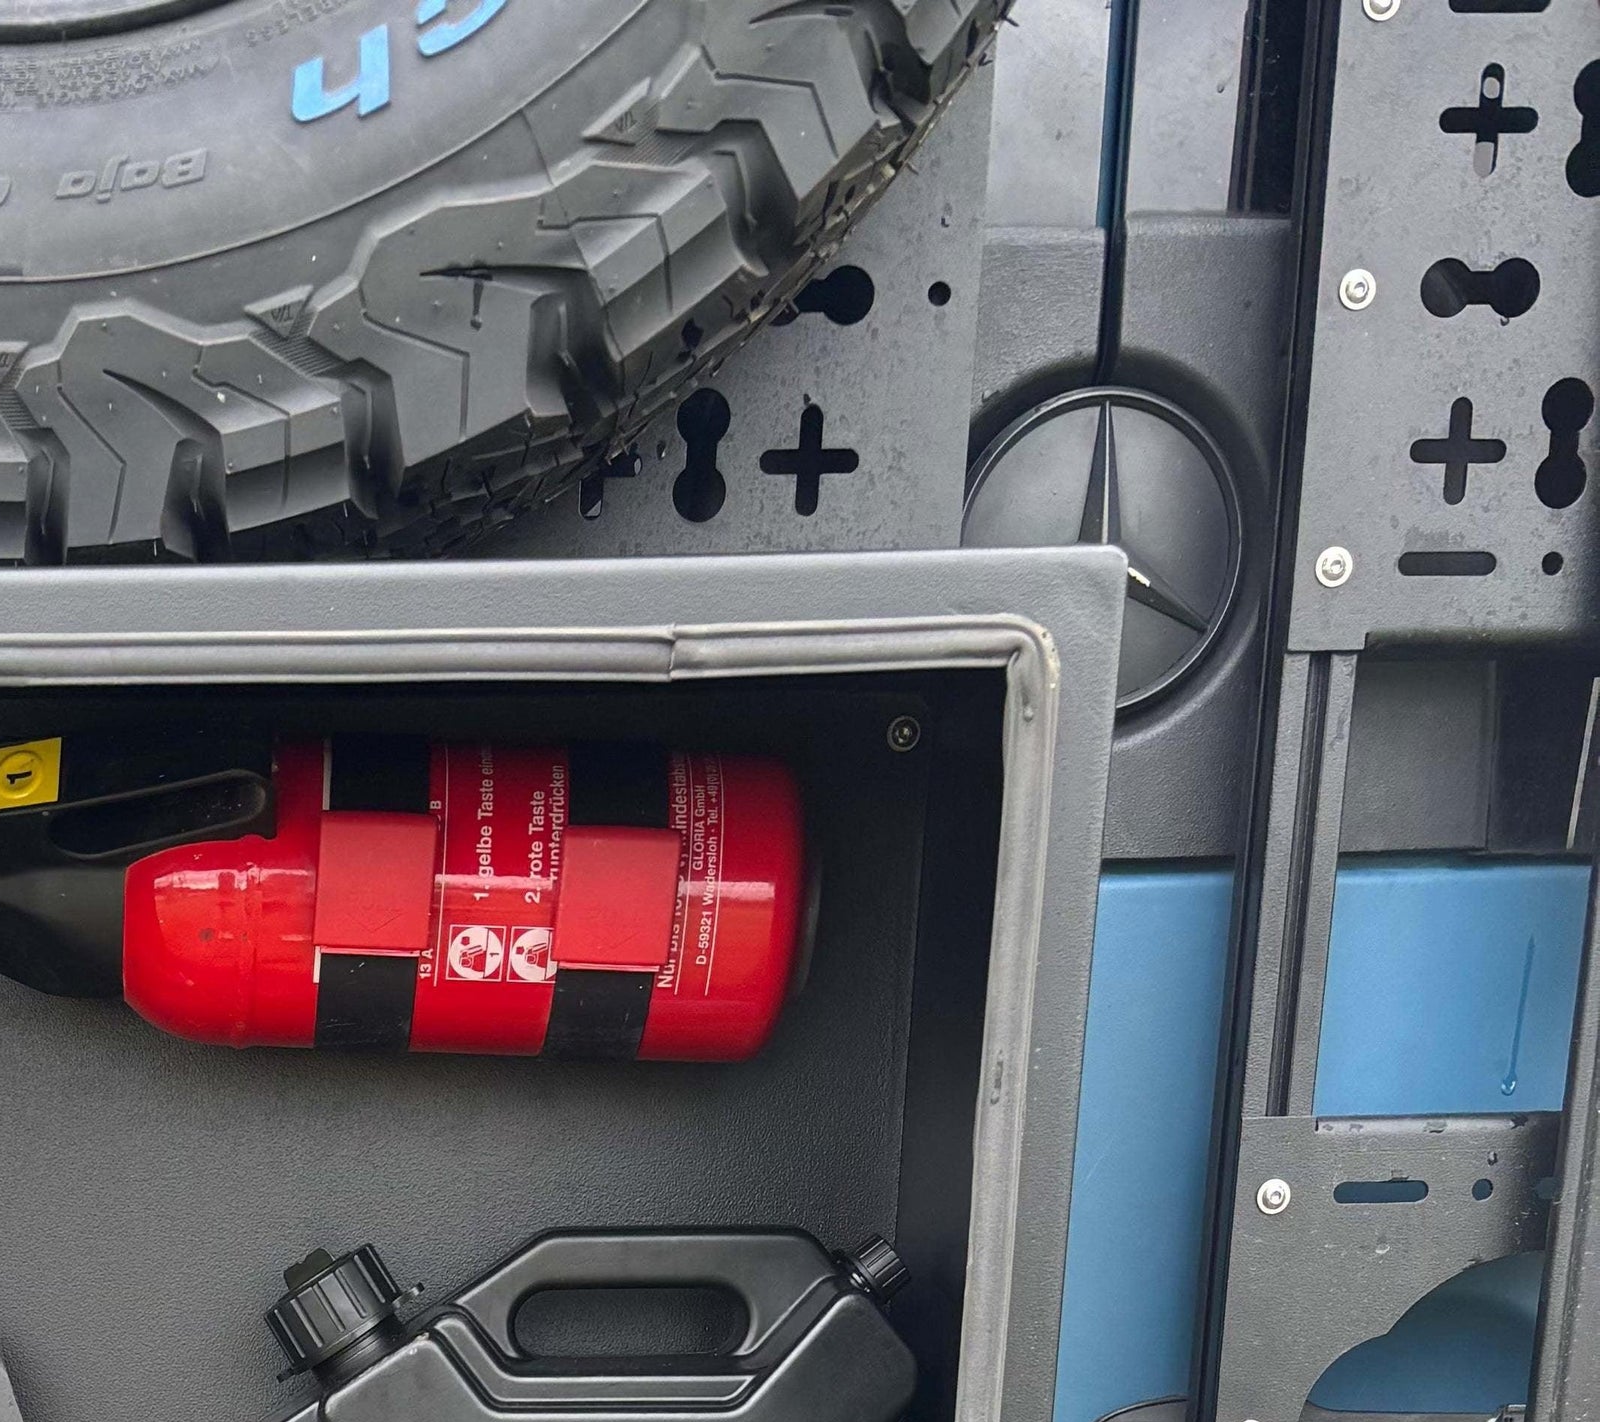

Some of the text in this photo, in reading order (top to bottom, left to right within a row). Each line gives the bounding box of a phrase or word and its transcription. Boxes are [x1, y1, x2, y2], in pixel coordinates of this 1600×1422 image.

[55, 147, 208, 203] Baja
[5, 770, 33, 785] 1
[477, 779, 494, 820] Taste
[528, 791, 545, 836] Taste
[692, 785, 706, 871] GLORIA GmbH
[475, 826, 495, 878] gelbe
[528, 841, 544, 880] rote
[701, 836, 718, 906] Wadersloh
[695, 911, 714, 966] D-59321
